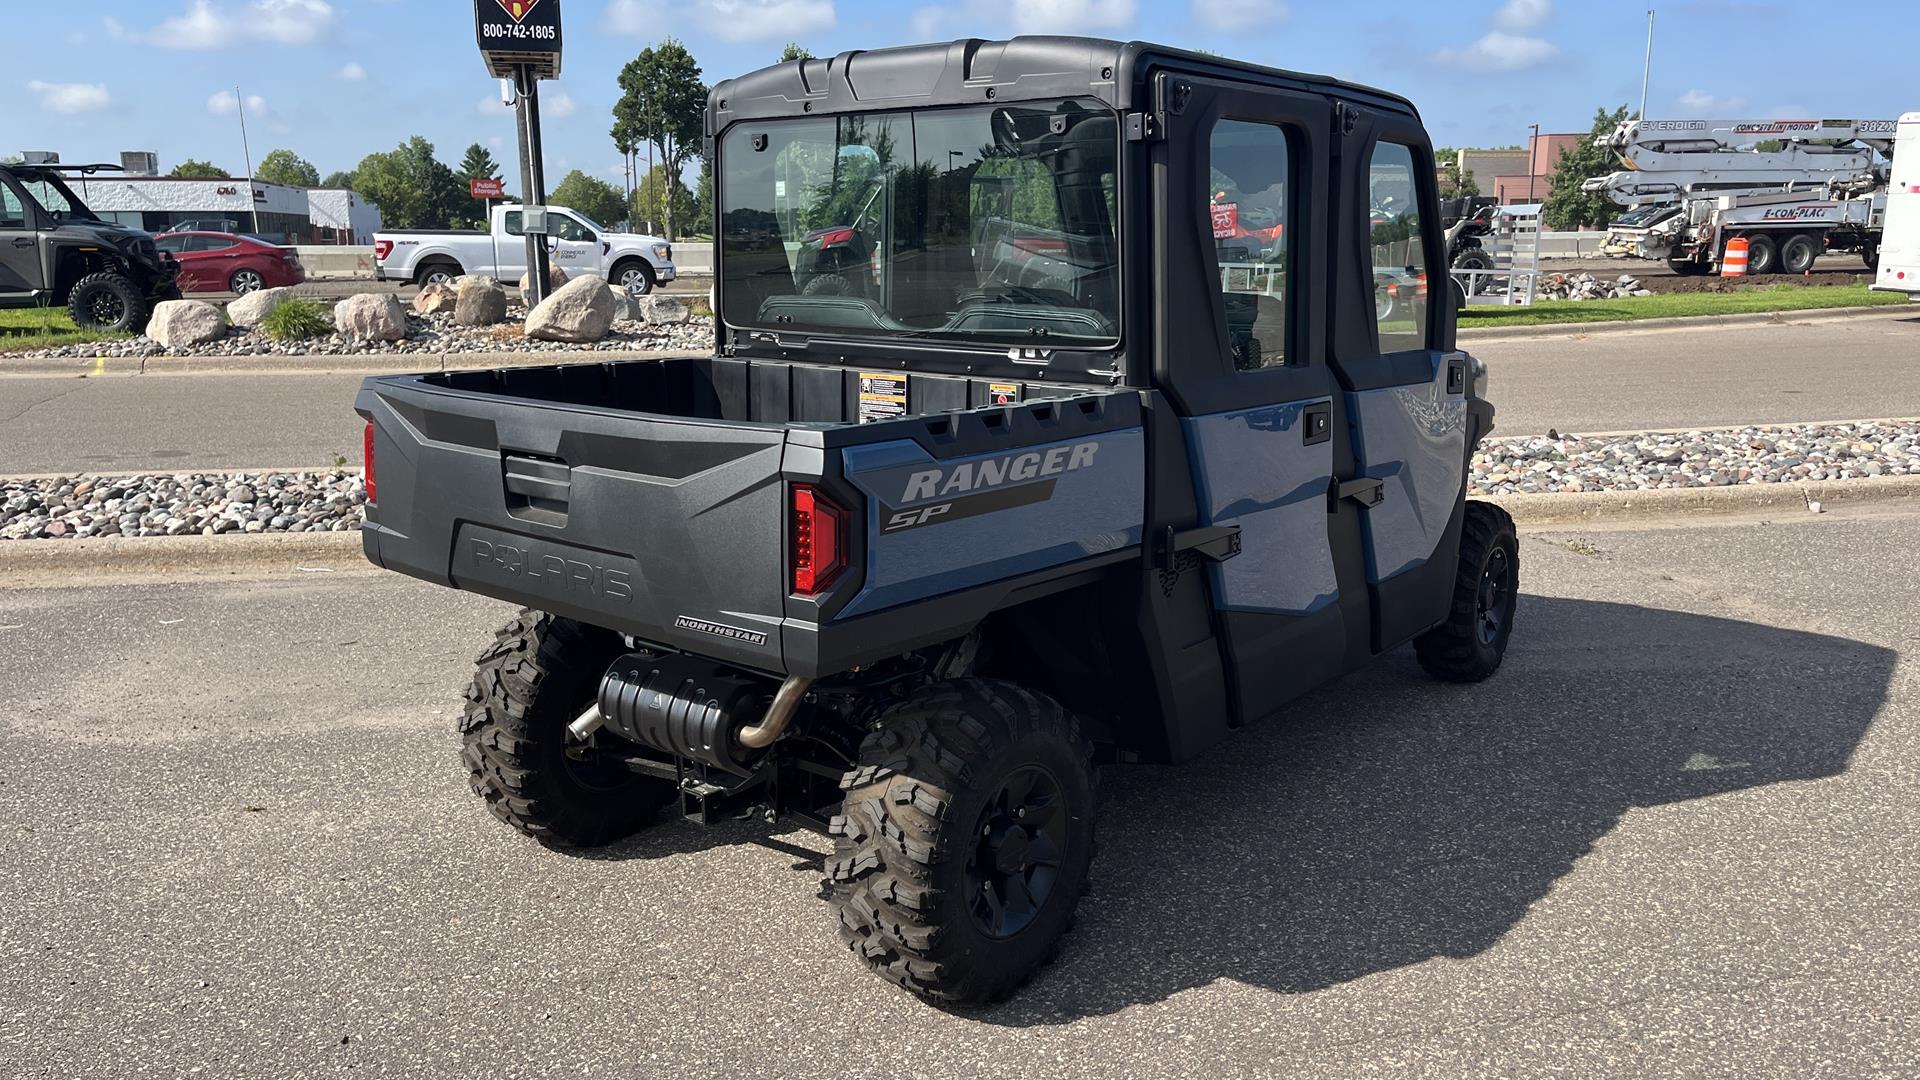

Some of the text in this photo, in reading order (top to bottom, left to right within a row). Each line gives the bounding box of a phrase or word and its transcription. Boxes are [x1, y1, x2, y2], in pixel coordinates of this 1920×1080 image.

[483, 23, 555, 39] 800-742-1805
[1640, 120, 1706, 131] EVERDIGM
[1786, 123, 1815, 131] MOTION
[900, 442, 1099, 503] RANGER
[885, 503, 952, 531] SP
[470, 537, 634, 605] POLARIS
[679, 618, 762, 643] NORTHSTAR
